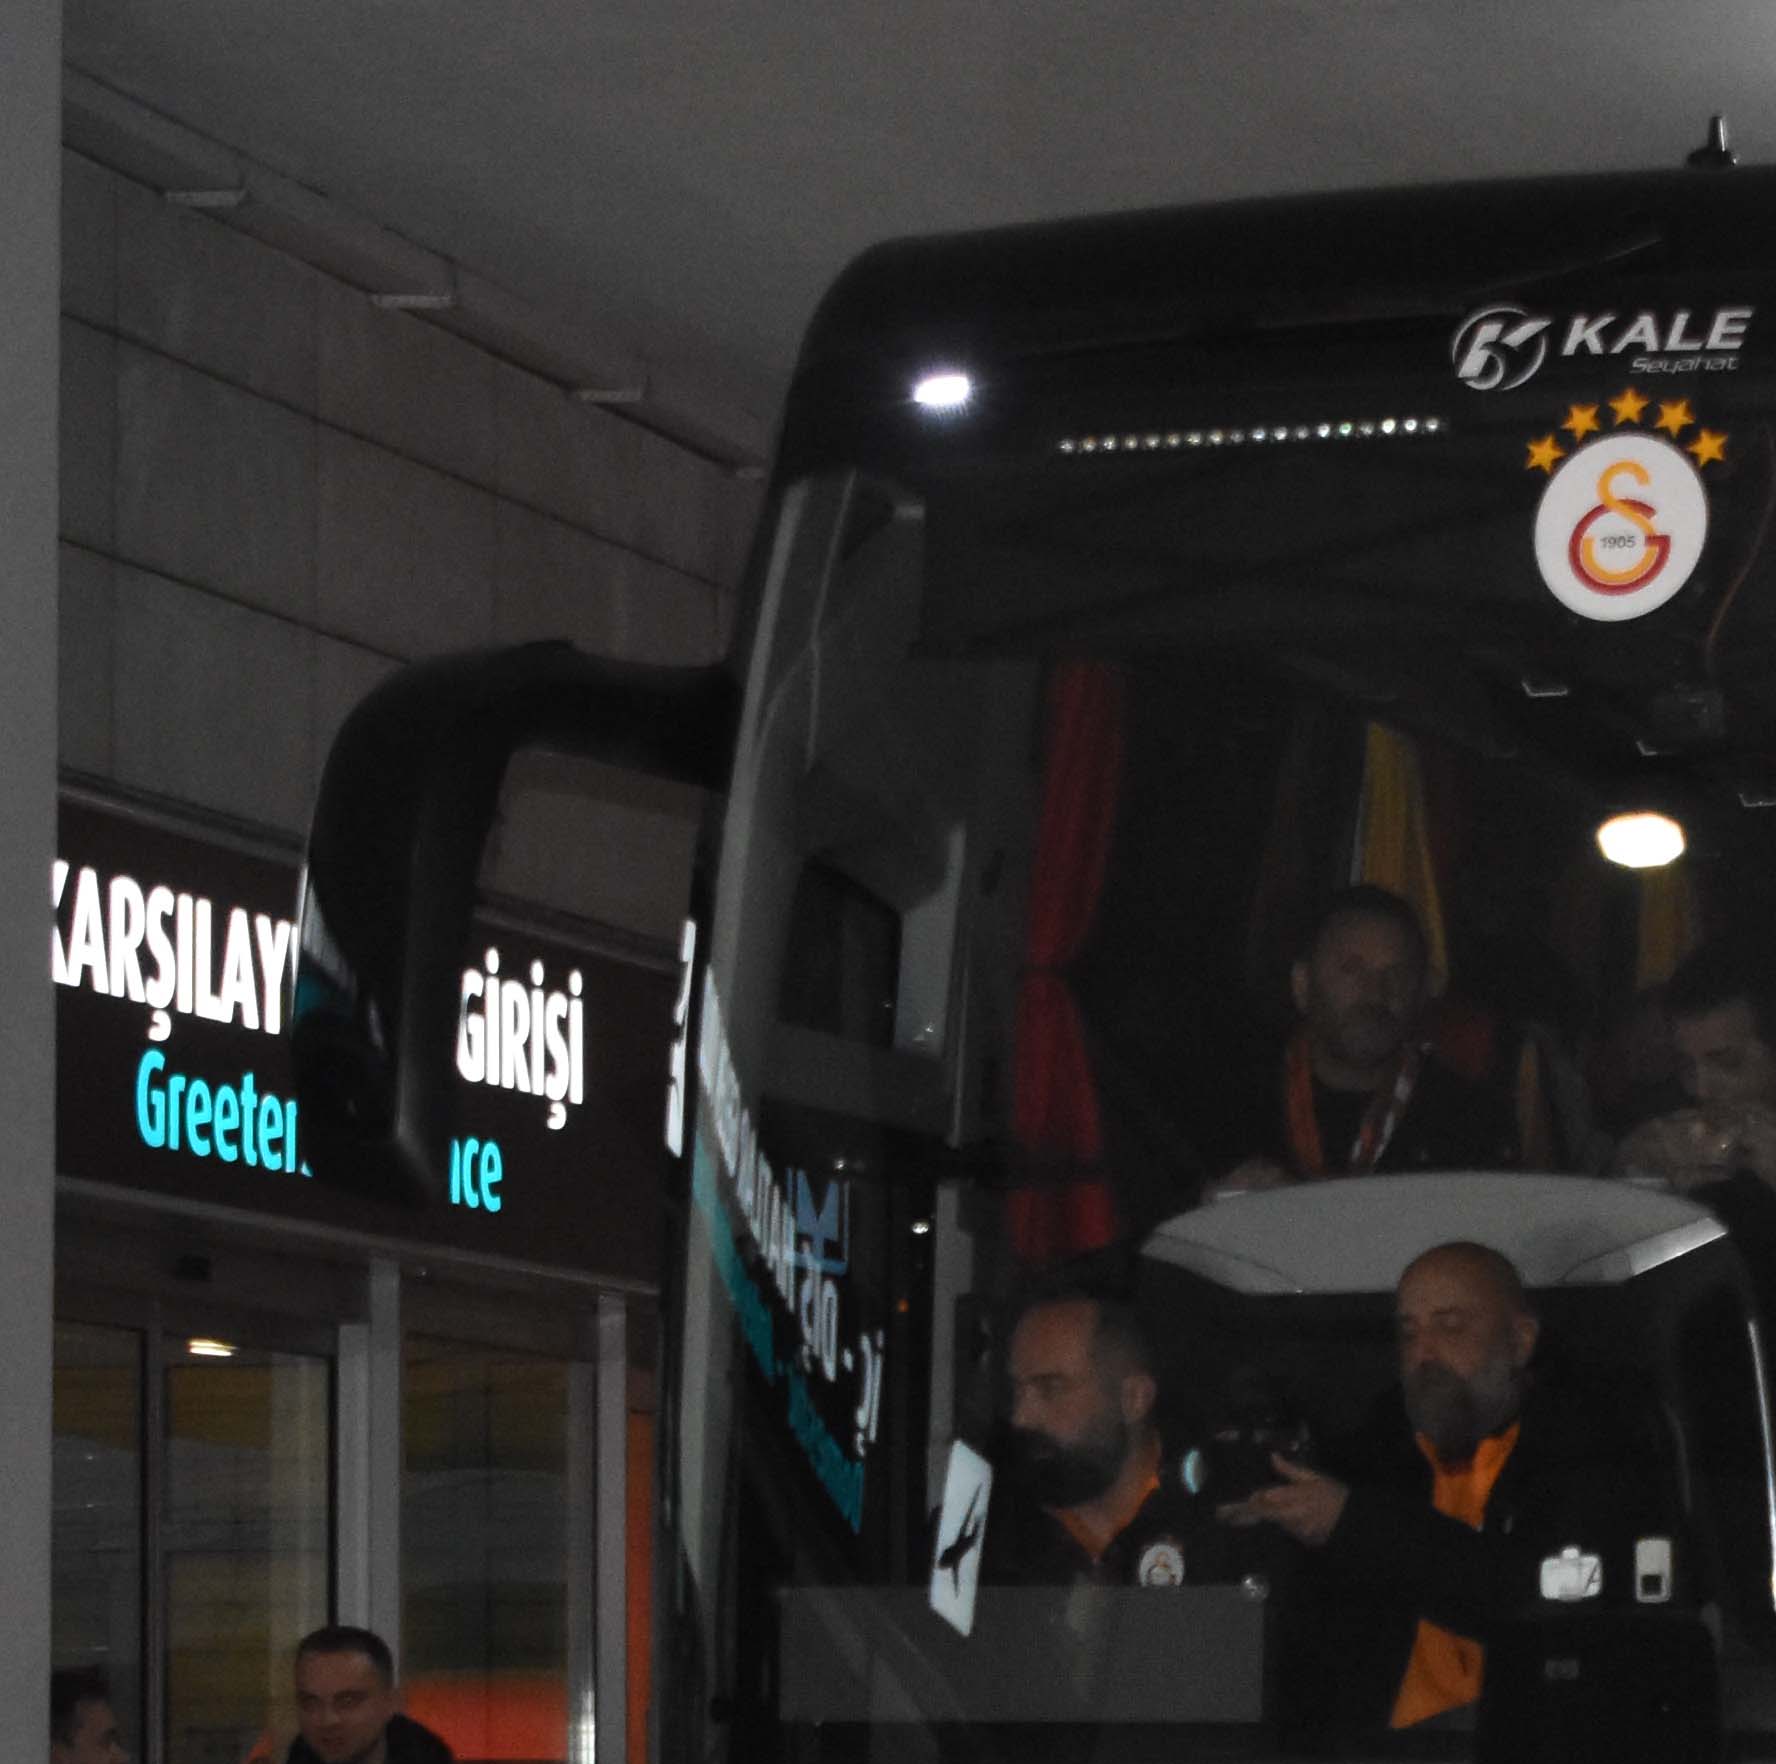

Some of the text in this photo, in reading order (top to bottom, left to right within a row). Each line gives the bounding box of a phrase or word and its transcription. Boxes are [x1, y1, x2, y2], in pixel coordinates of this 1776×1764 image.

[1562, 308, 1754, 356] KALE
[1629, 355, 1740, 375] Seyahat
[1600, 534, 1636, 549] 1905
[456, 946, 584, 1130] GİRİŞİ
